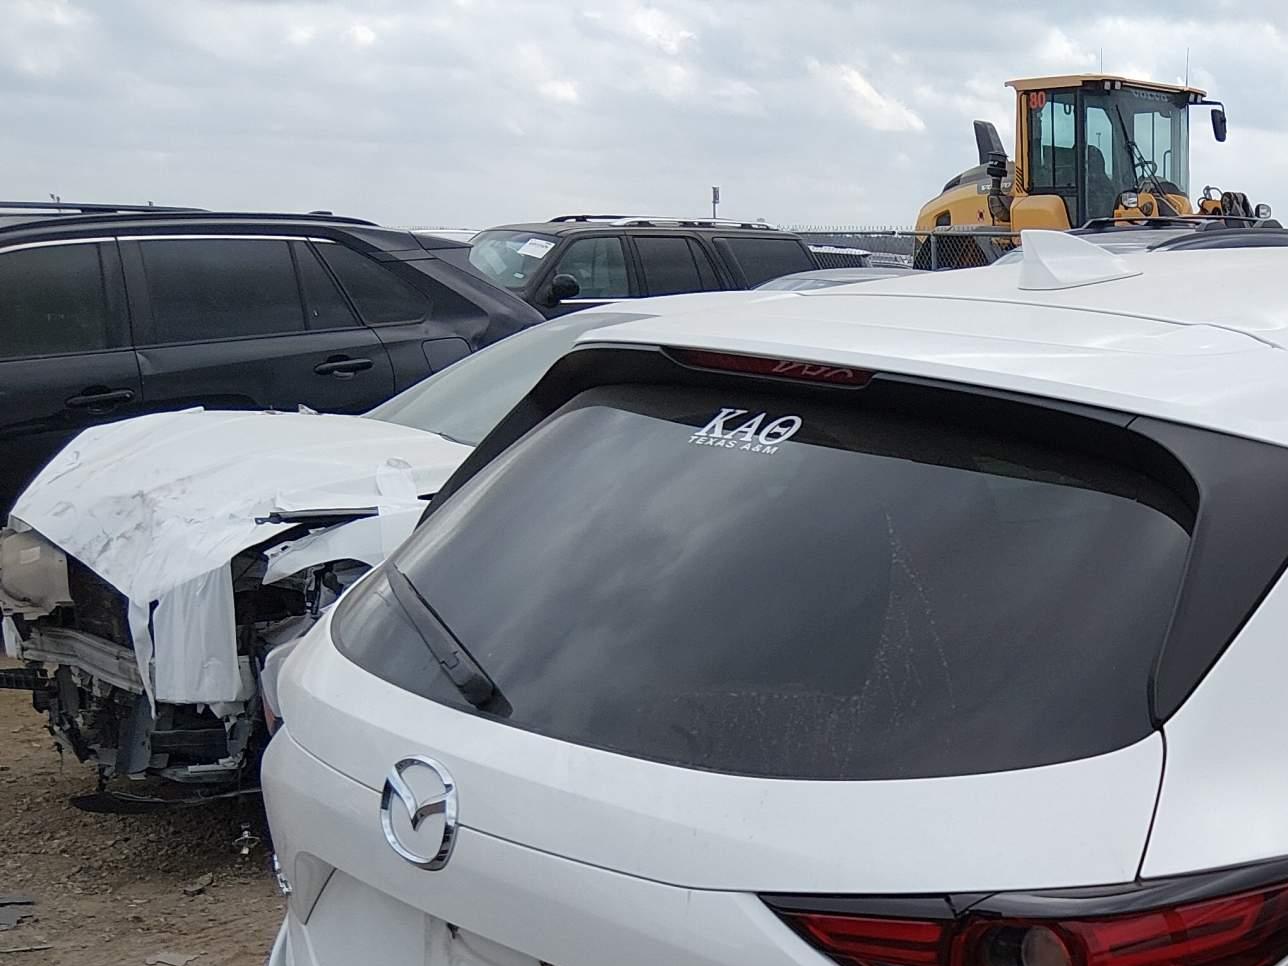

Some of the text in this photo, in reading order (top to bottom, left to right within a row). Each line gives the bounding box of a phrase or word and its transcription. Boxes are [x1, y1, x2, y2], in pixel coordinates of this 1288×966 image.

[1030, 91, 1045, 109] 80
[688, 435, 779, 455] TEXAS A&M
